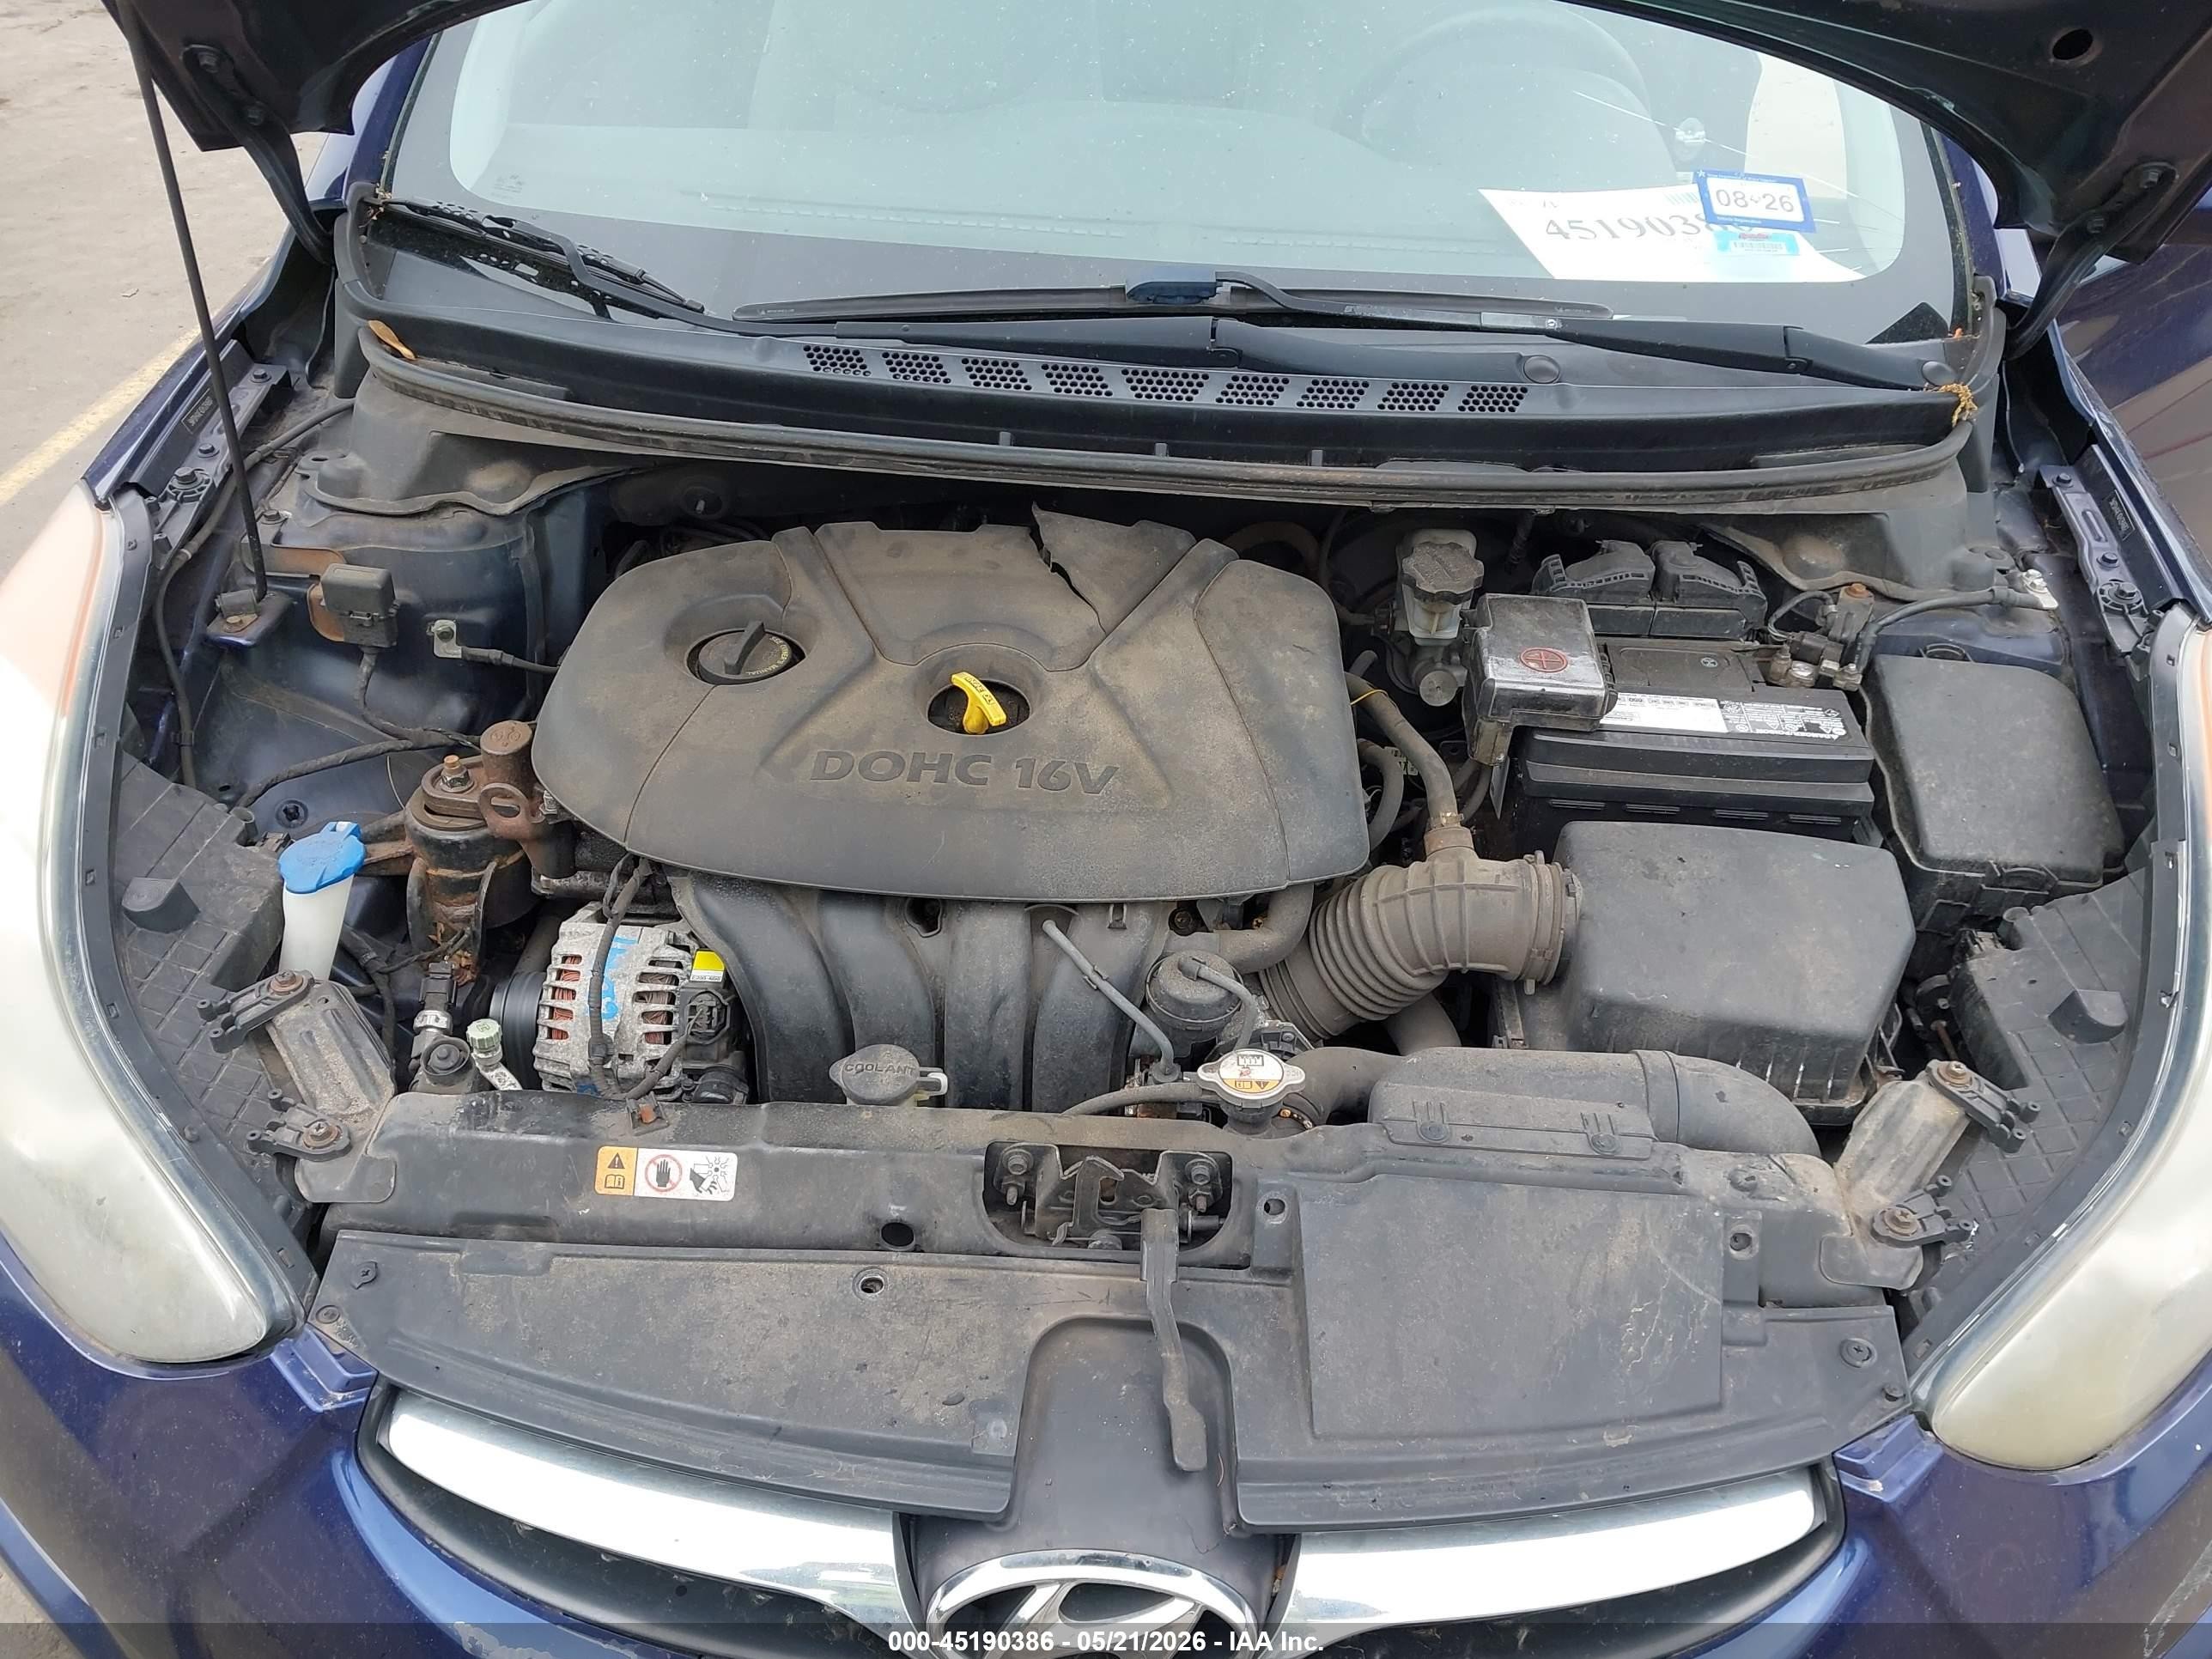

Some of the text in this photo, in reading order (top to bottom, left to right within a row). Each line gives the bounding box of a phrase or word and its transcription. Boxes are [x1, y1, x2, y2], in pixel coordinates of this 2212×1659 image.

[1716, 189, 1795, 213] 08 26
[1545, 213, 1753, 240] 451903
[810, 750, 1119, 795] DOHC 16V
[844, 1063, 916, 1077] COOLANT
